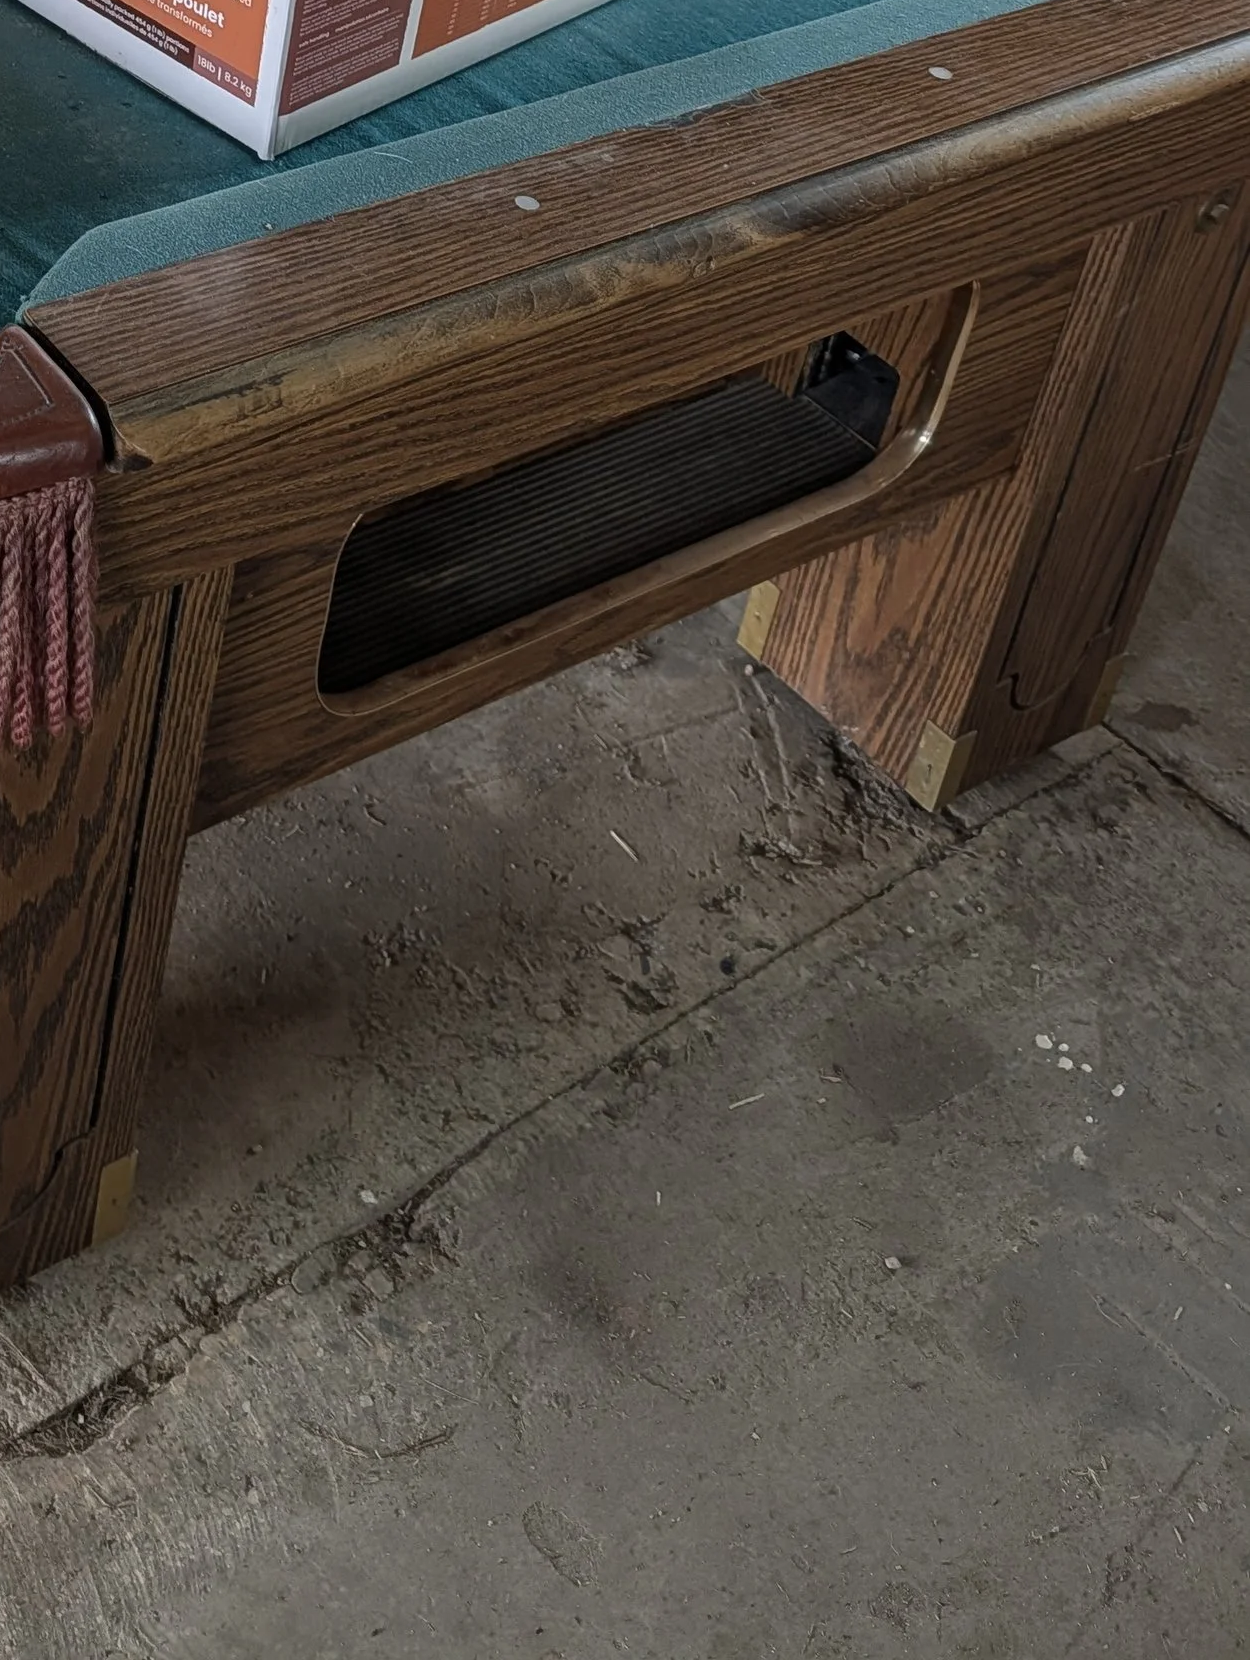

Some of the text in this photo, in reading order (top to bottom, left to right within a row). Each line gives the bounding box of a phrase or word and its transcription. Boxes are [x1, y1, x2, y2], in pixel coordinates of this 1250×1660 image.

[105, 6, 140, 31] individuelles
[139, 27, 147, 36] de
[158, 39, 164, 48] g
[114, 4, 135, 21] packed
[135, 17, 146, 28] 454
[166, 35, 190, 54] portions
[197, 55, 252, 98] 18lb 8.2 kg
